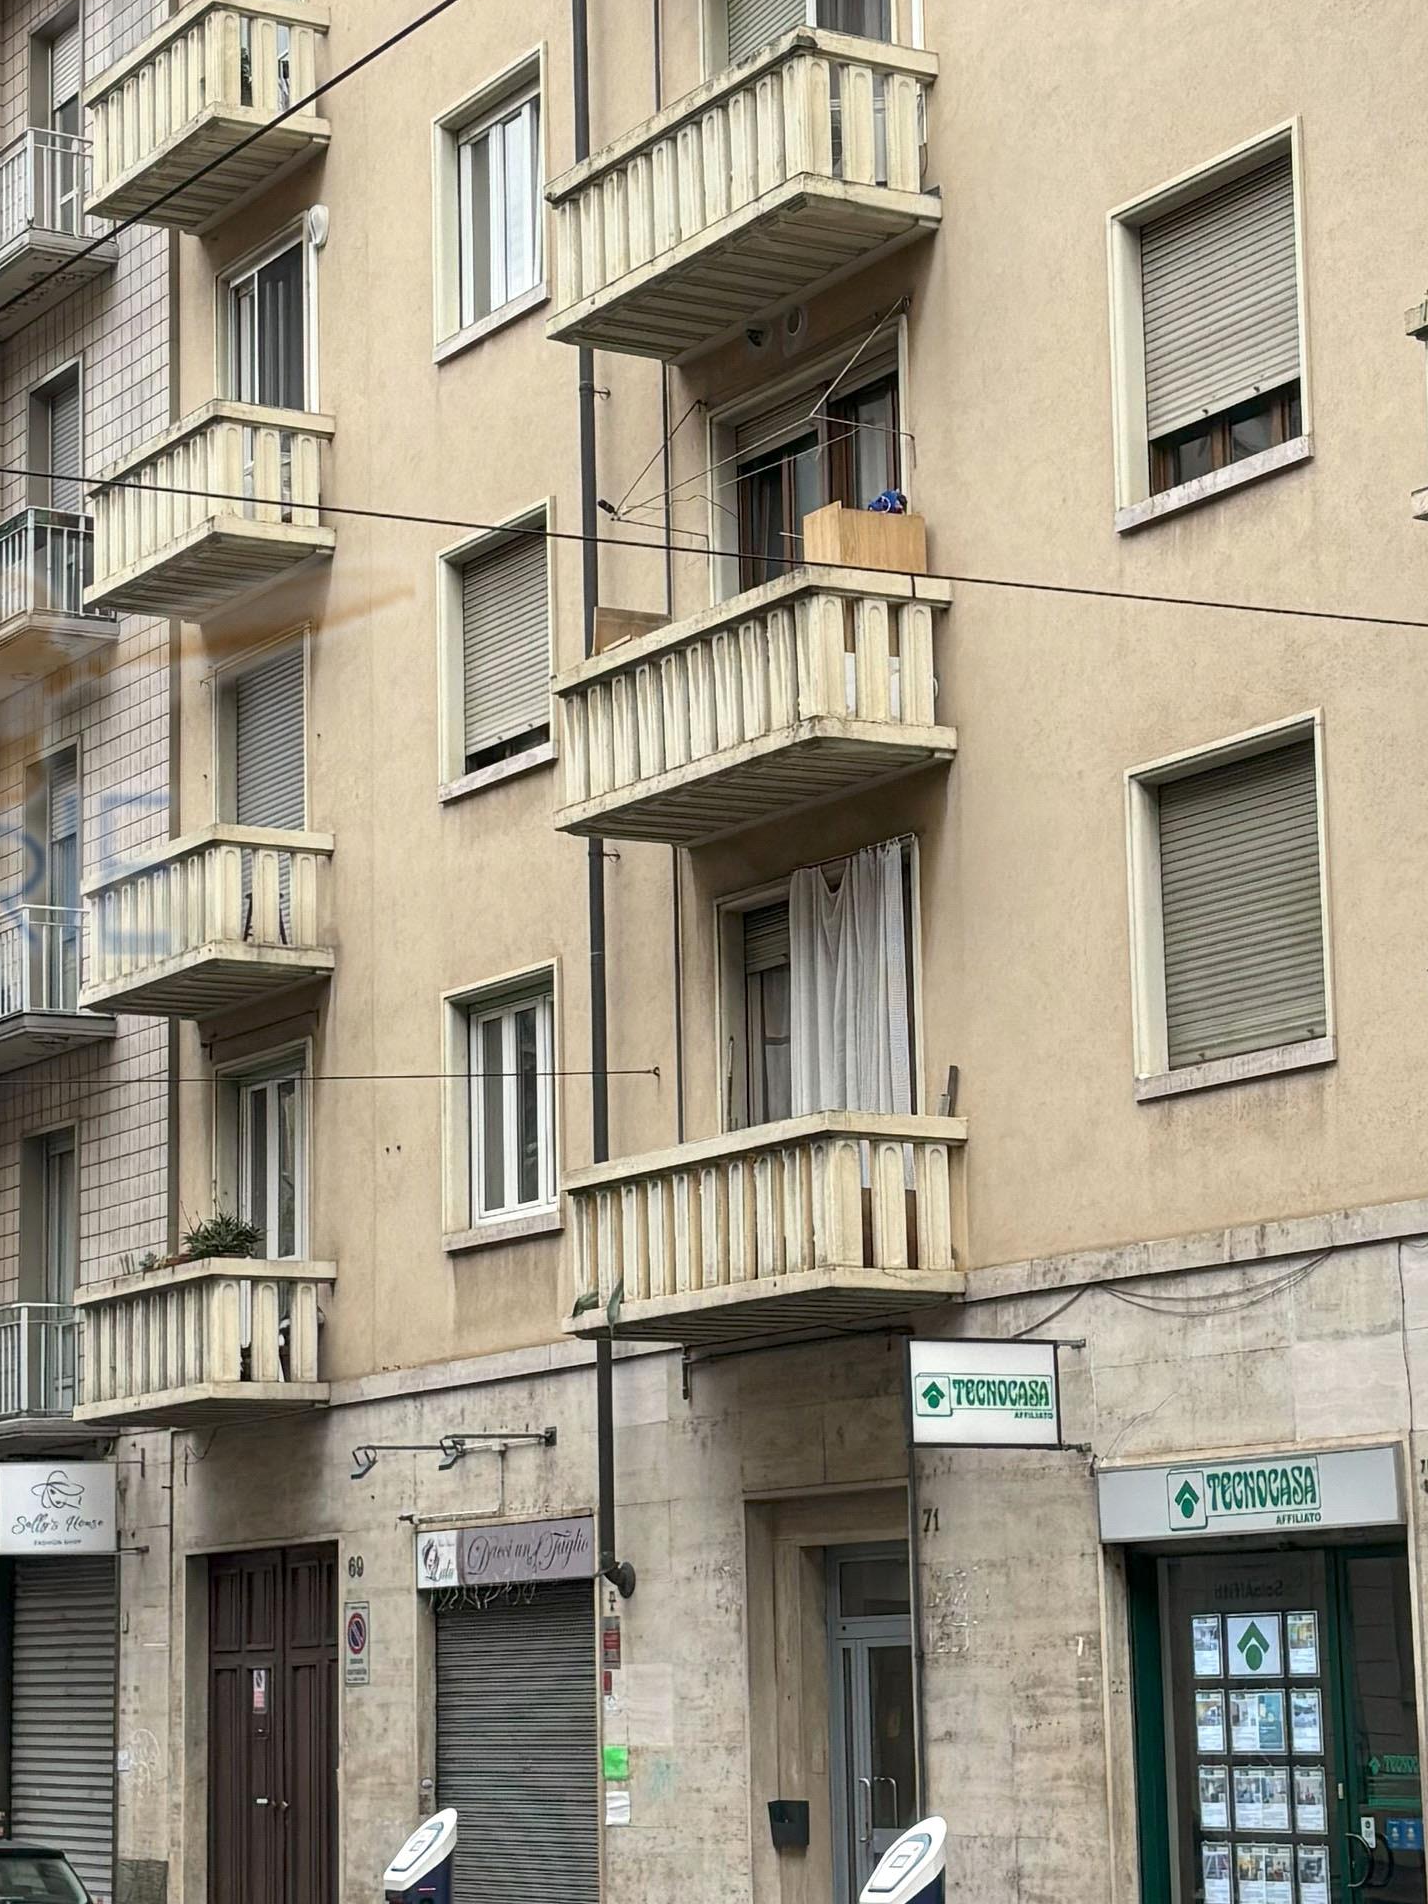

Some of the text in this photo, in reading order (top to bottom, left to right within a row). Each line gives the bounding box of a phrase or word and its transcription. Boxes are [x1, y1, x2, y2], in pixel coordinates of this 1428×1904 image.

[953, 1379, 1050, 1407] TECNOCASA
[1207, 1465, 1317, 1512] TECNOCASA
[923, 1507, 939, 1532] 71
[1276, 1512, 1322, 1526] AFFILIATO
[348, 1555, 364, 1578] 69
